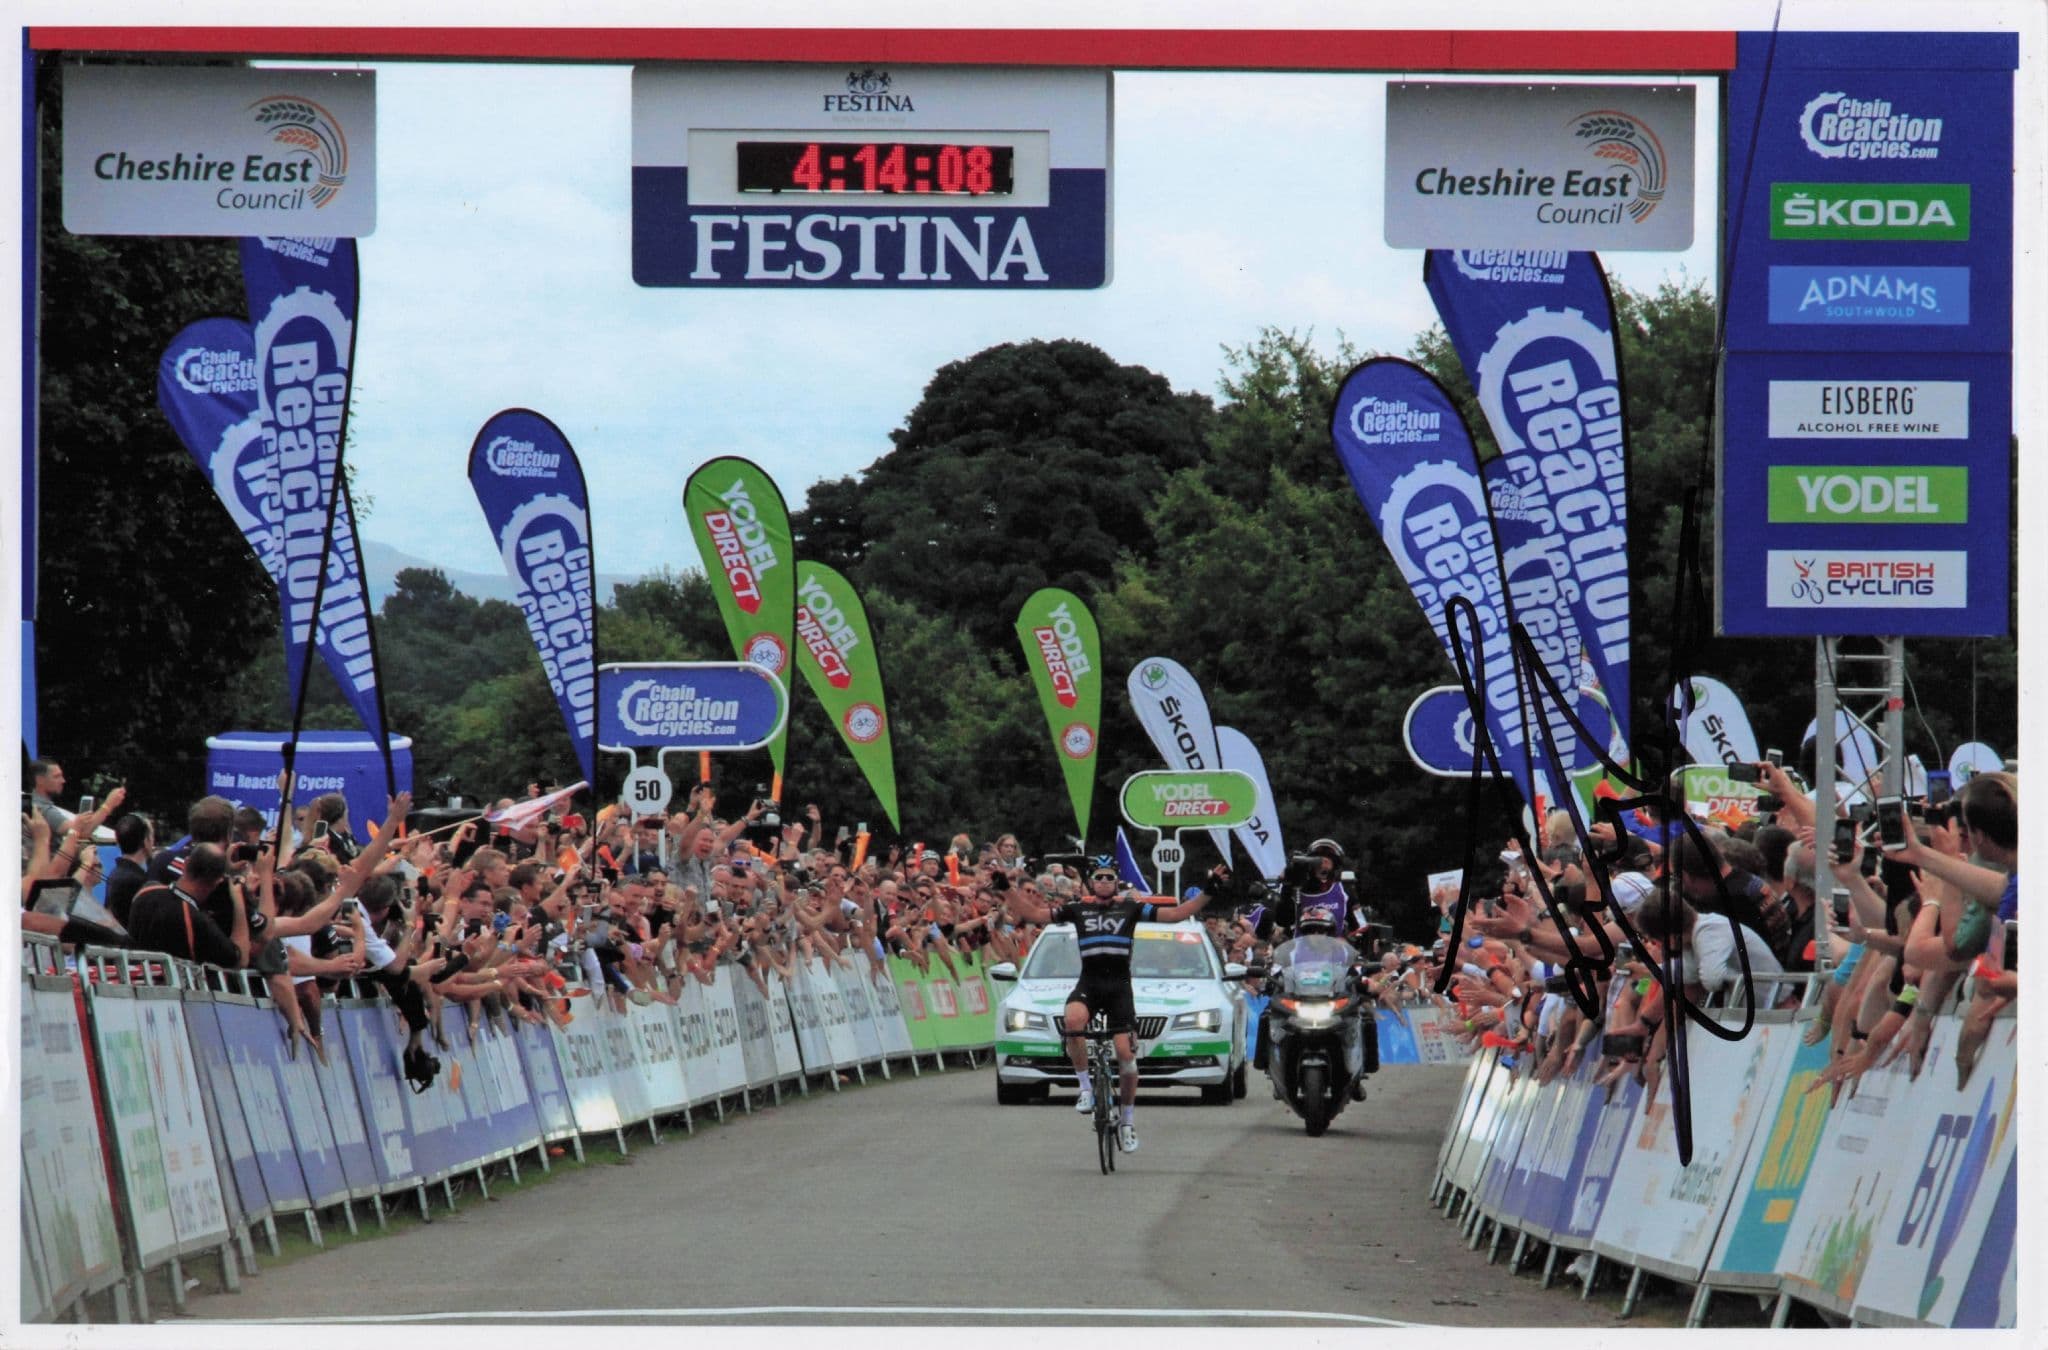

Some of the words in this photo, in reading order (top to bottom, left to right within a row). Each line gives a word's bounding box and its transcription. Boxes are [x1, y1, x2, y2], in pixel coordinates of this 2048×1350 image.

[823, 95, 915, 112] FESTINA
[1837, 98, 1891, 117] Chain
[1819, 114, 1943, 142] Reaction
[1847, 141, 1938, 160] cycles.com
[95, 152, 235, 182] Cheshire
[243, 155, 312, 184] East
[793, 144, 993, 193] 4:14:08
[1415, 167, 1554, 197] Cheshire
[1563, 170, 1632, 198] East
[216, 187, 304, 210] Council
[1784, 193, 1956, 226] ŠKODA
[1537, 202, 1622, 225] Council
[689, 214, 1050, 282] FESTINA
[1826, 306, 1915, 317] SOUTHWOLD
[201, 350, 240, 364] Chain
[1373, 400, 1408, 414] Chain
[1822, 387, 1914, 415] EISBERG
[1363, 411, 1440, 432] Reaction
[1797, 423, 1863, 433] ALCOHOL
[1868, 423, 1900, 433] FREE
[1903, 423, 1940, 433] WINE
[506, 439, 534, 452] Chain
[498, 448, 560, 468] Reaction
[1797, 474, 1940, 515] YODEL
[1508, 358, 1630, 666] Reaction
[720, 478, 777, 582] YODEL
[706, 514, 760, 601] DIRECT
[1826, 562, 1934, 578] BRITISH
[1827, 579, 1934, 596] CYCLING
[798, 575, 859, 659] YODEL
[520, 529, 595, 739] Reaction
[797, 607, 850, 677] DIRECT
[1048, 602, 1091, 683] YODEL
[1035, 630, 1075, 698] DIRECT
[650, 685, 695, 701] Chain
[635, 698, 739, 720] Reaction
[660, 718, 736, 737] cycles.com
[1160, 696, 1206, 770] ŠKOD
[298, 775, 345, 791] Cycles
[635, 780, 661, 800] 50
[1152, 783, 1214, 800] YODEL
[1164, 801, 1224, 816] DIRECT
[1157, 849, 1180, 863] 100
